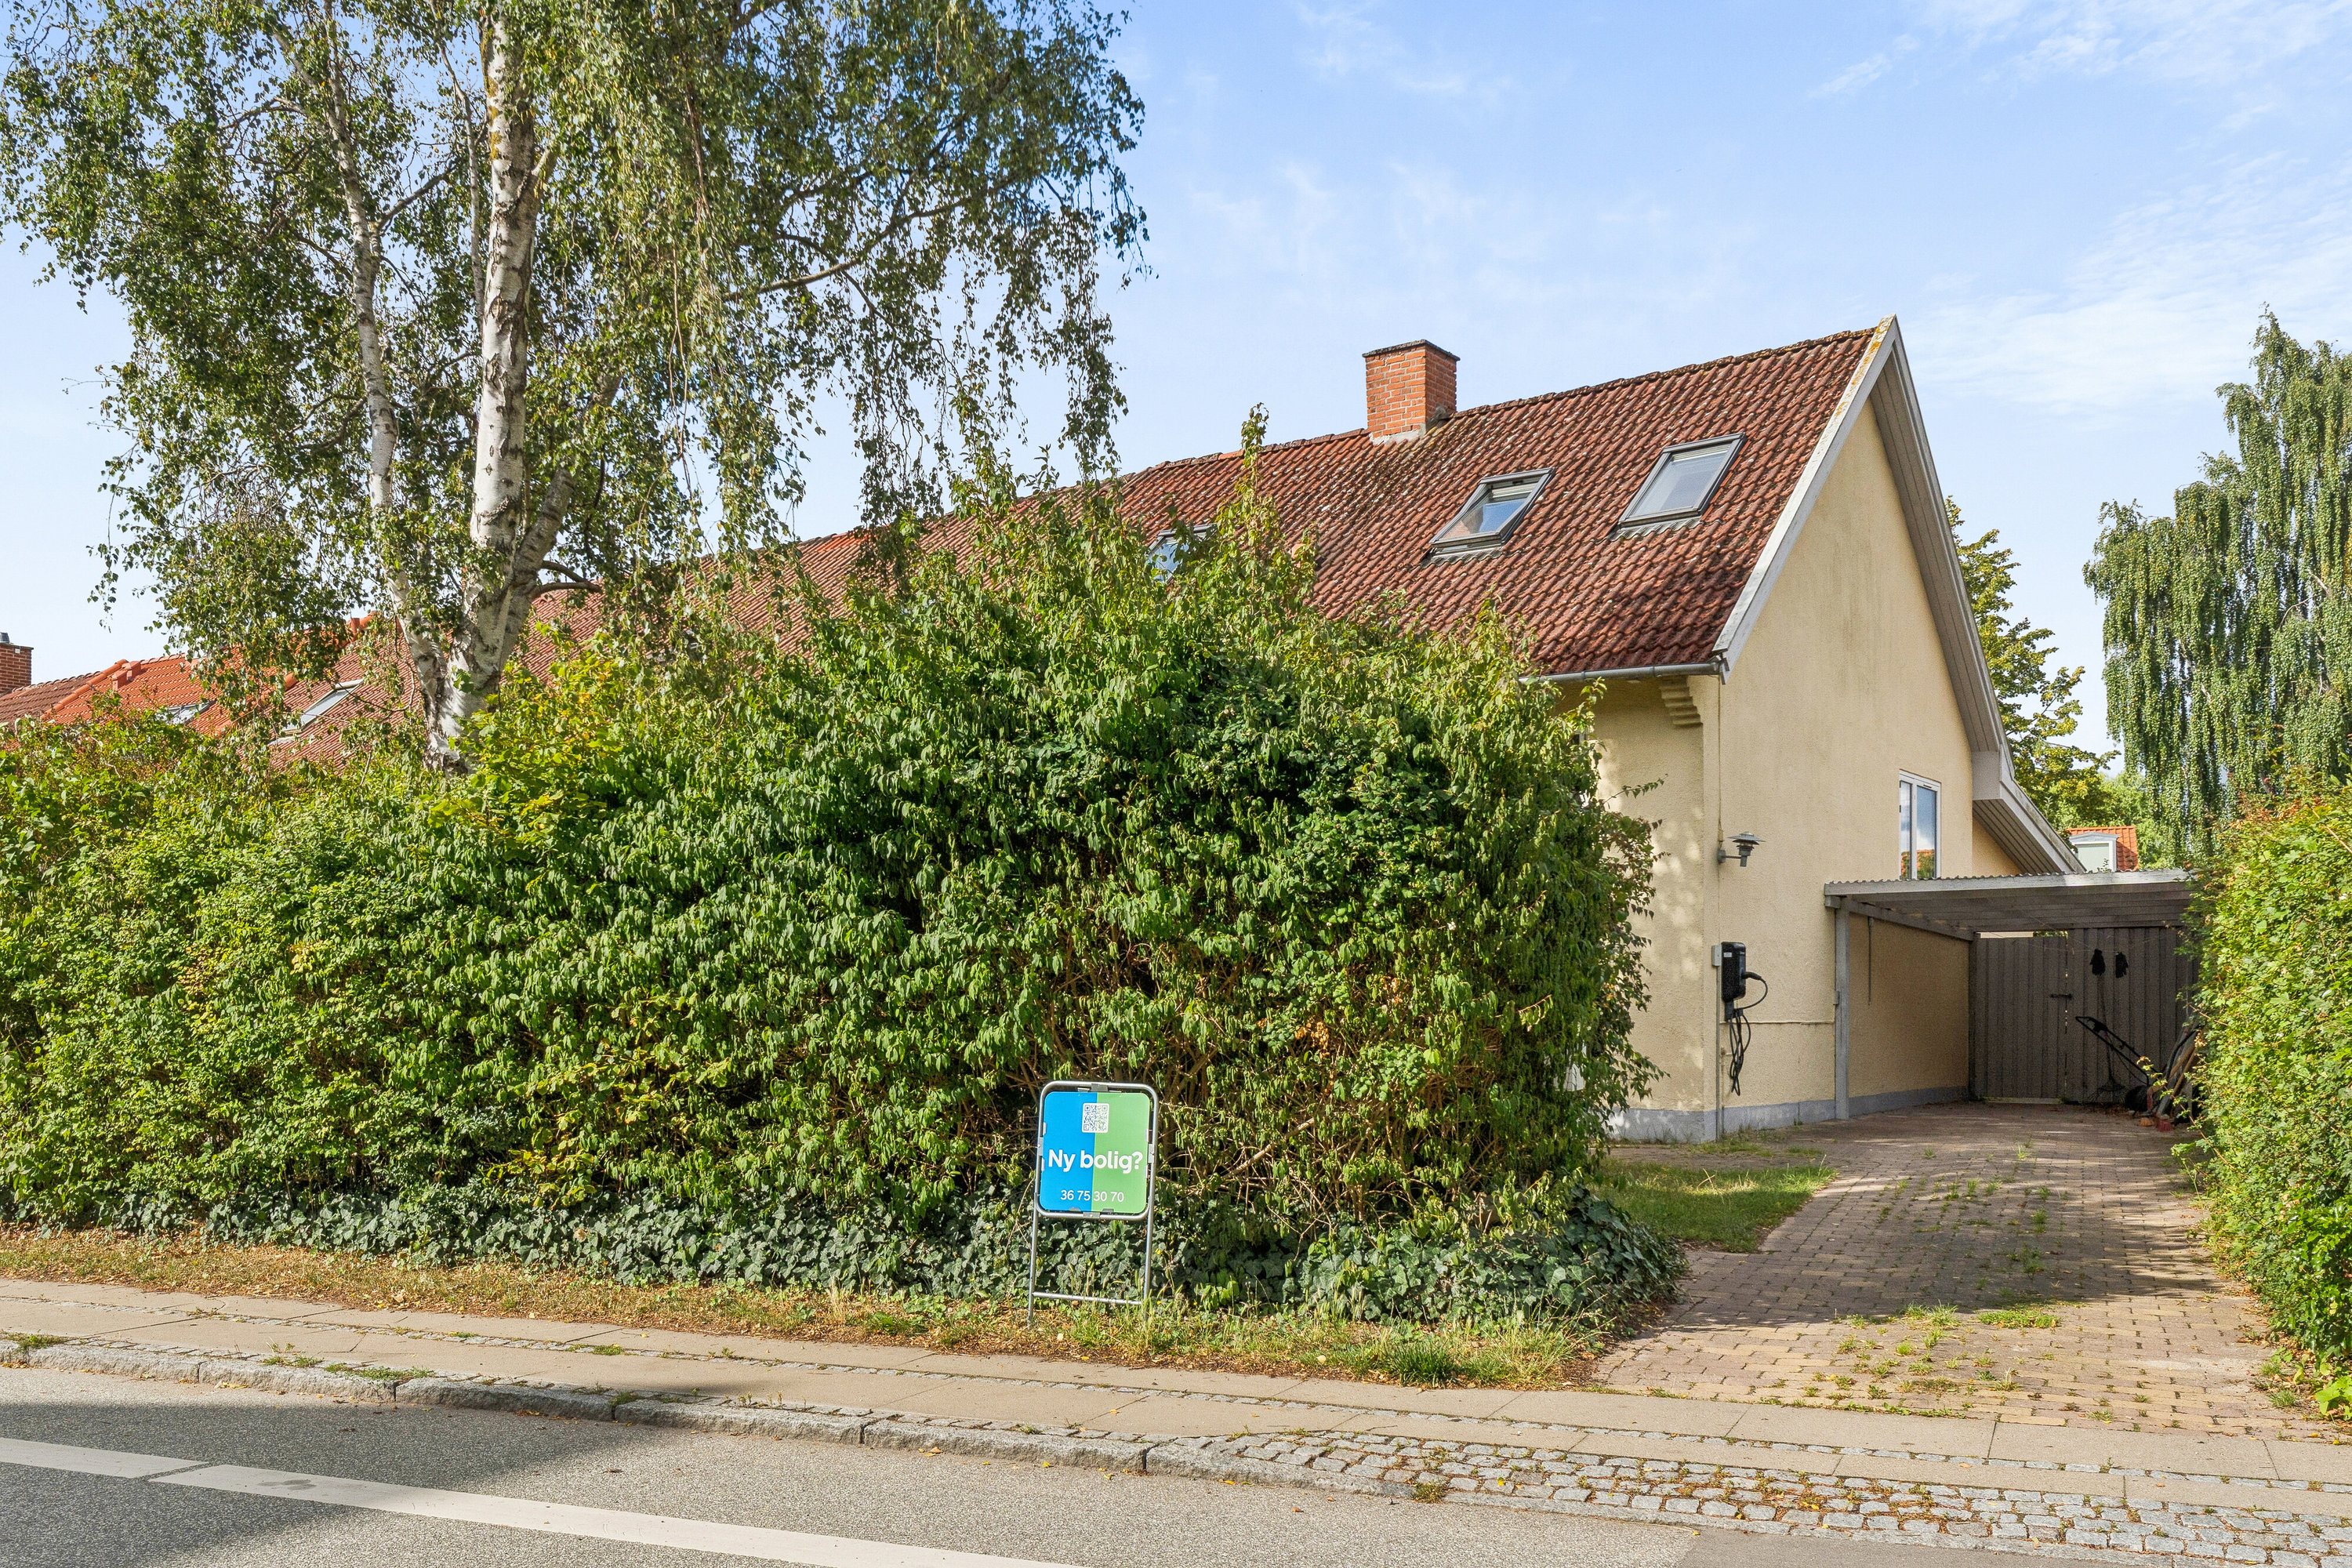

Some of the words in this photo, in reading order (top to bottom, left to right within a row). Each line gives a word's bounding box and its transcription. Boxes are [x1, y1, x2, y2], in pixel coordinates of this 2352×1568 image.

[1048, 1149, 1076, 1172] Ny
[1080, 1150, 1143, 1174] bolig?
[1060, 1190, 1074, 1200] 36
[1077, 1191, 1091, 1200] 75
[1094, 1191, 1107, 1201] 30
[1111, 1192, 1124, 1202] 70
